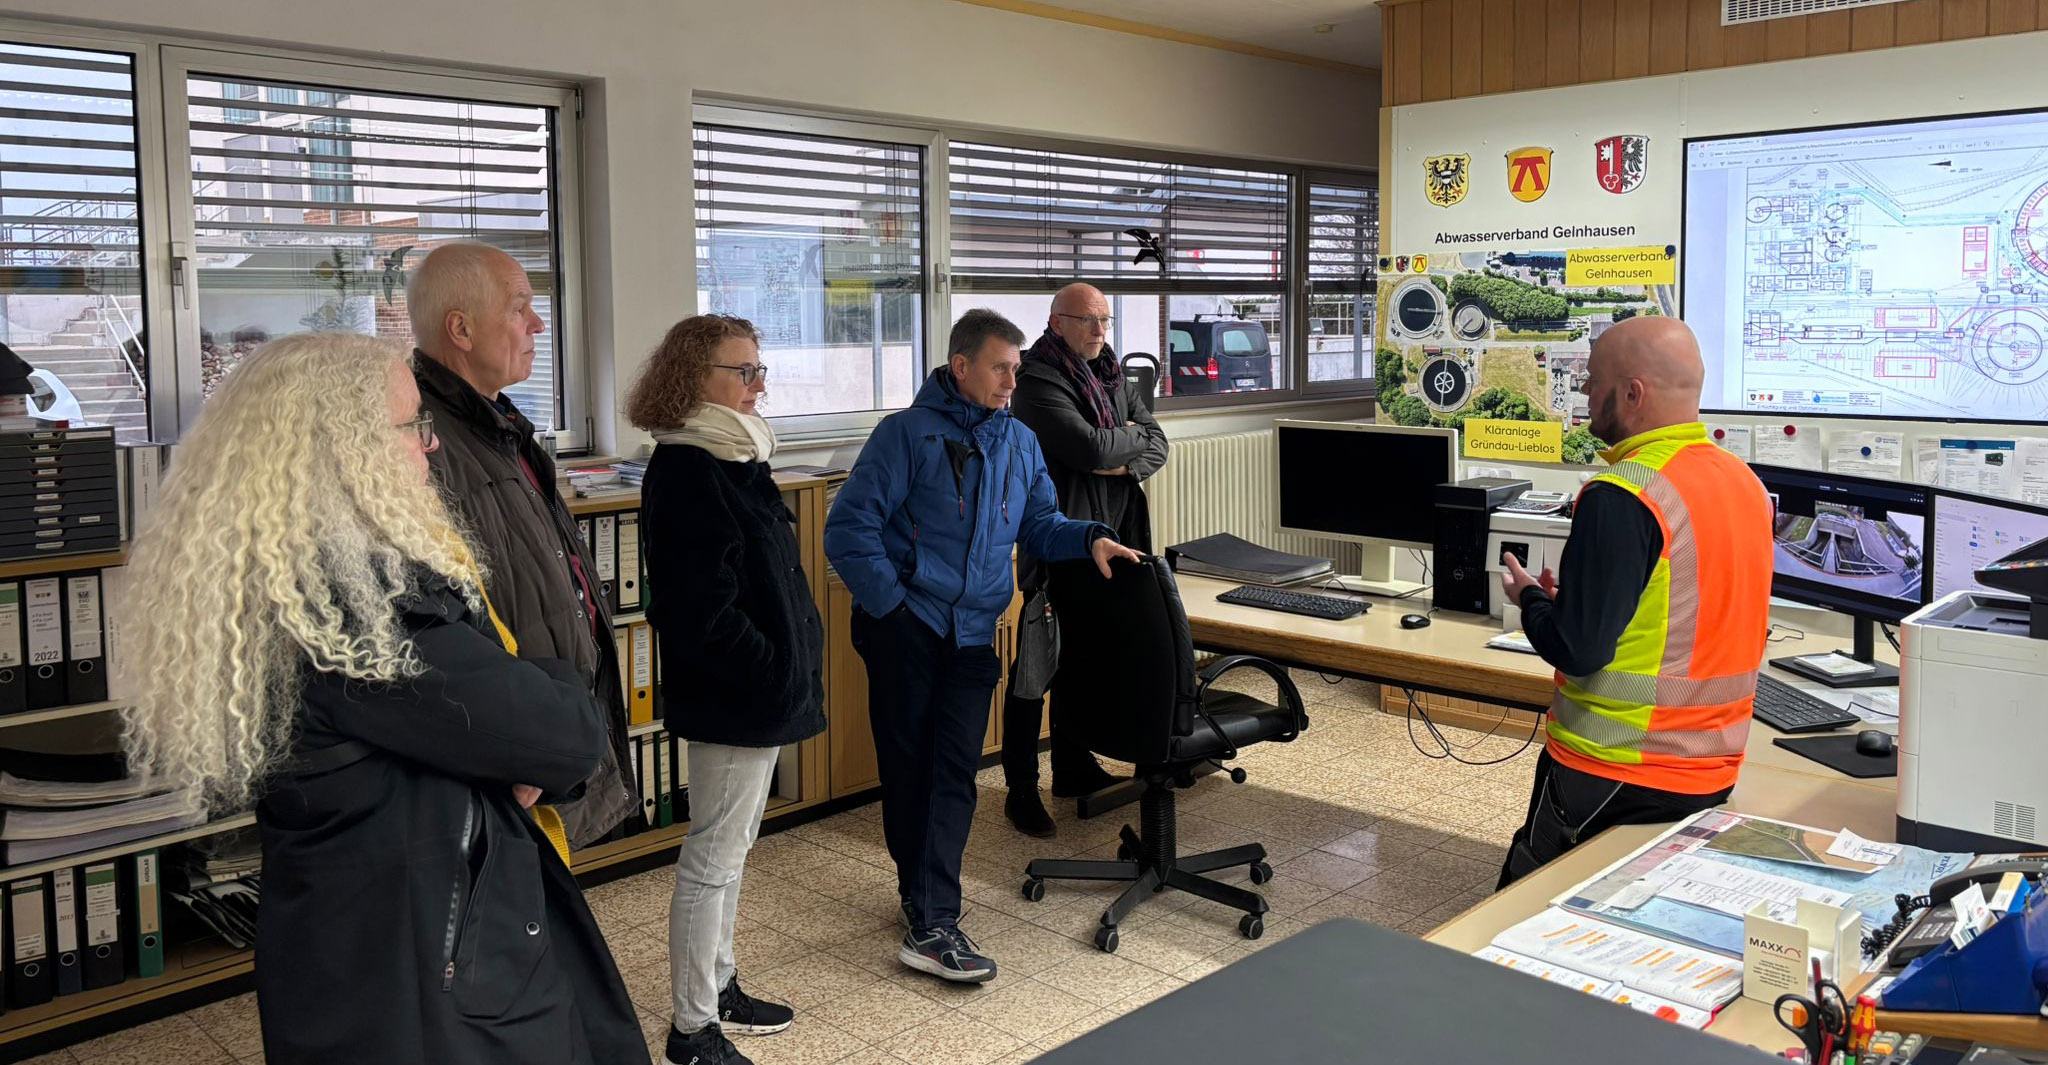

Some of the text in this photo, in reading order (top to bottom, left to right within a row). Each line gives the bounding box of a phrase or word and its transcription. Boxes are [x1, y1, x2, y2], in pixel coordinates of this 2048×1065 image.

[1434, 224, 1636, 245] Abwasserverband Gelnhausen
[1569, 251, 1672, 264] Abwasserverband
[1585, 267, 1653, 279] Gelnhausen
[1484, 424, 1541, 439] Kläranlage
[1470, 439, 1555, 454] Gründau-Lieblos
[34, 650, 60, 662] 2022
[1749, 936, 1784, 954] MAXX
